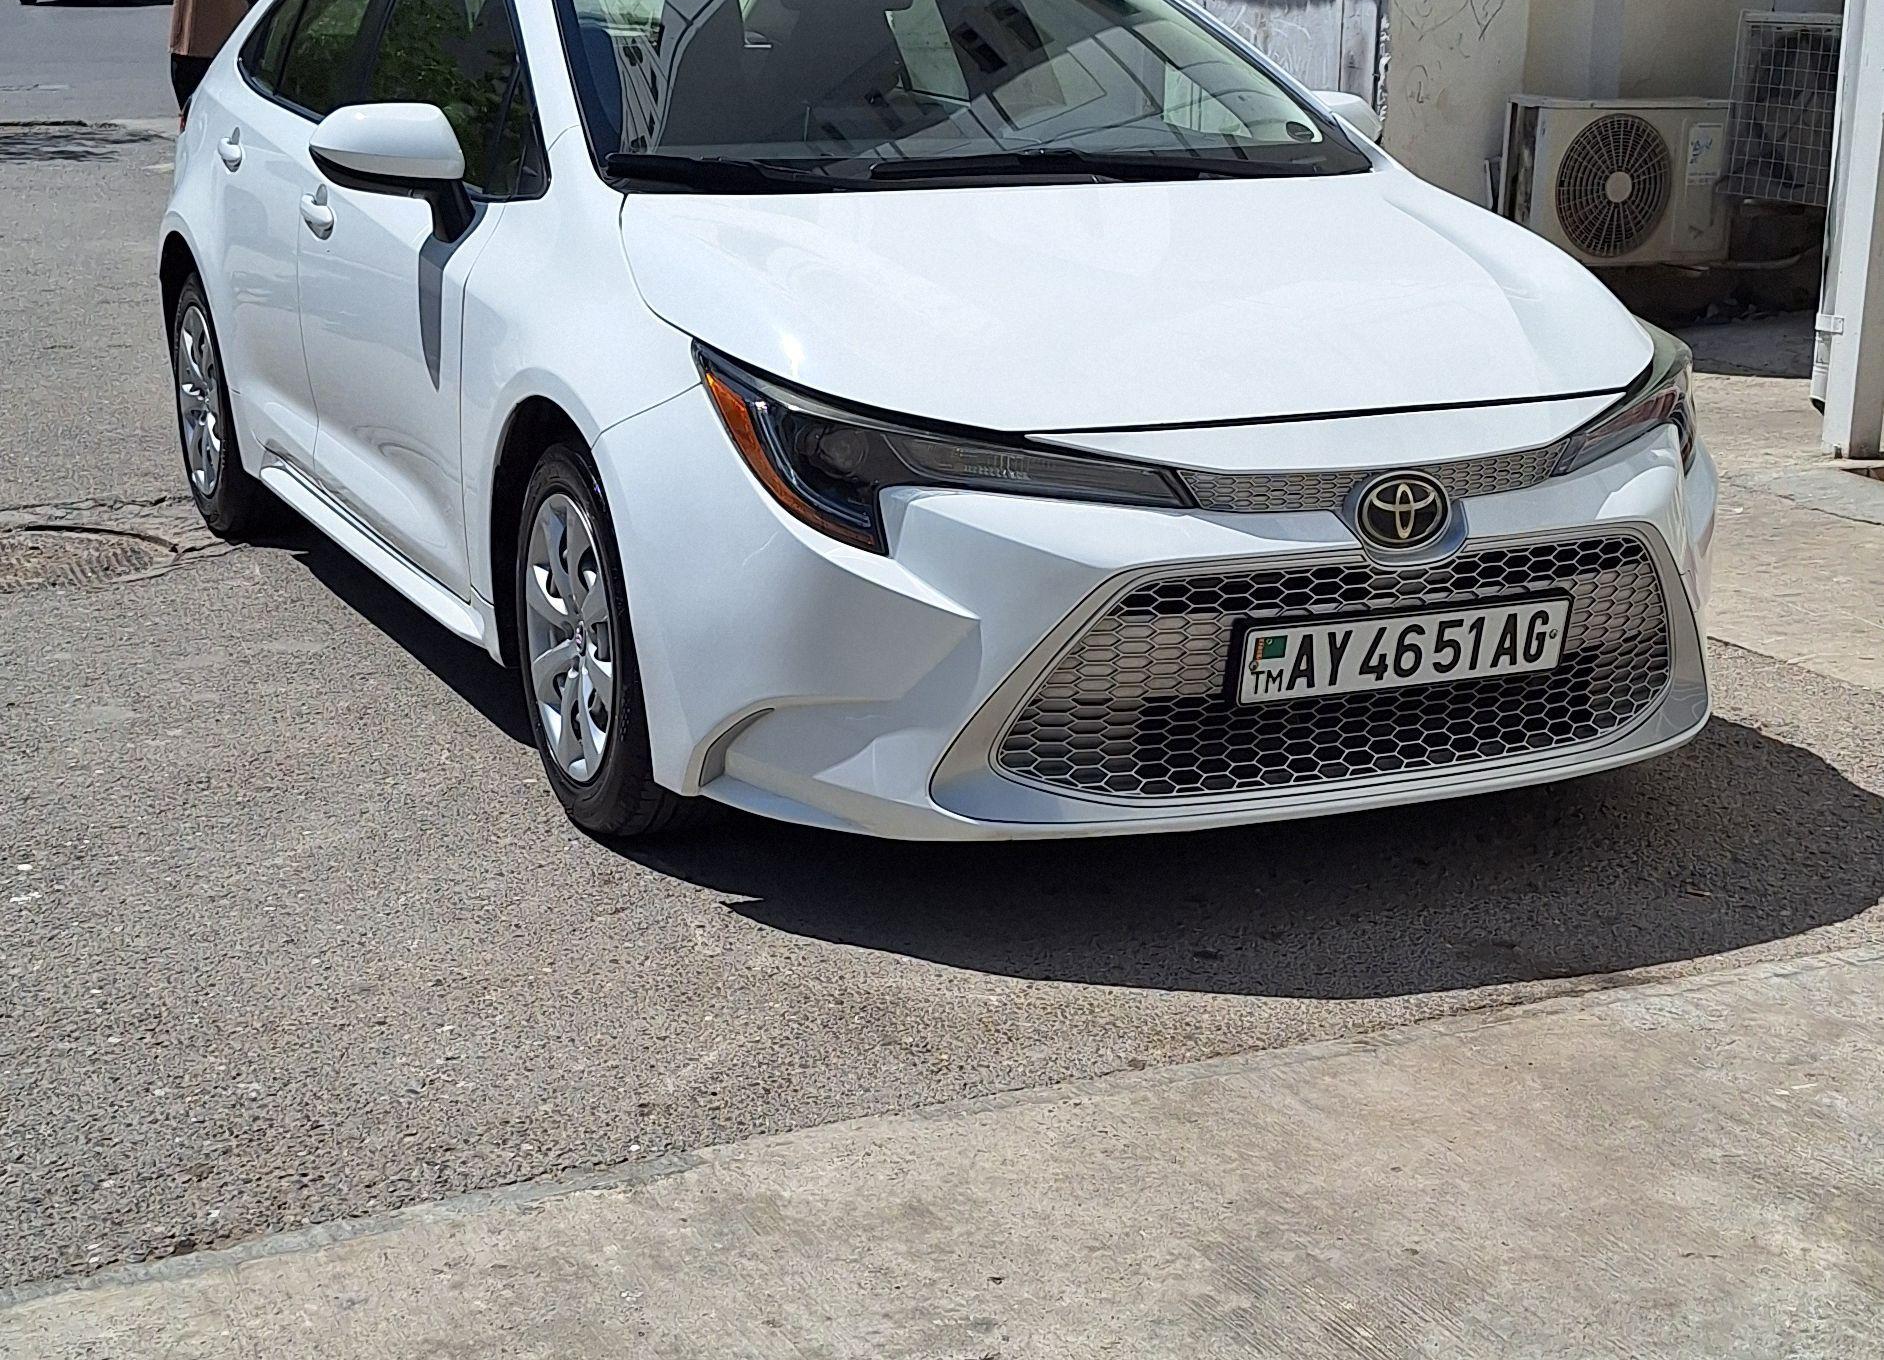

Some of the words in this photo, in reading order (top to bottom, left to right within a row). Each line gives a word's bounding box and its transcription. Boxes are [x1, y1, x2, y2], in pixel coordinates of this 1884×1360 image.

[1286, 629, 1353, 691] AY
[1489, 609, 1550, 669] AG
[1250, 668, 1284, 695] TM
